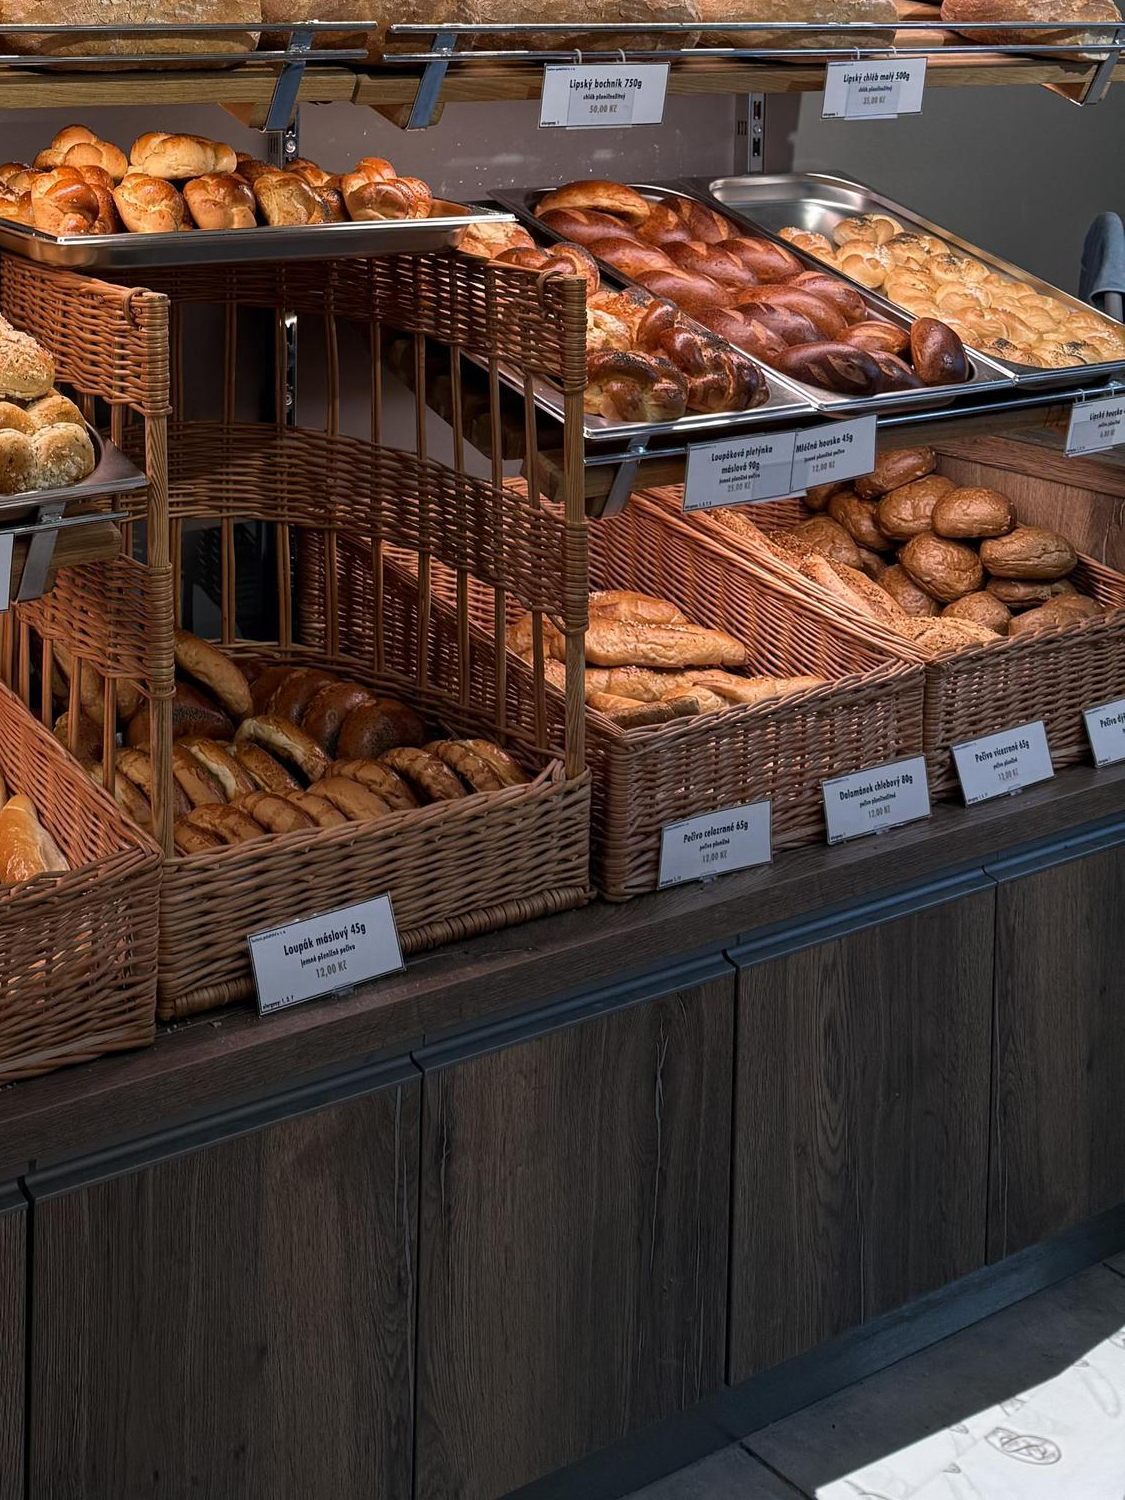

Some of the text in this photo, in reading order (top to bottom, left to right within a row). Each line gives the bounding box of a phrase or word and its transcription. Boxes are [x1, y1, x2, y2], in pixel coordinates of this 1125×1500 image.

[570, 79, 642, 90] Lipský bochník 750g
[843, 71, 910, 84] Lipský chléb malý 500g
[589, 104, 618, 113] 50,00 Kč
[796, 433, 853, 453] Mléčná houska 45g
[712, 445, 773, 461] Loupáková pletýnka
[722, 461, 760, 474] máslová 90g
[975, 751, 993, 762] Pečivo
[840, 774, 913, 800] Dalamánek chlebový 80g
[684, 820, 748, 843] Pečivo celozrnné 65g
[284, 923, 366, 956] Loupák máslový 45g
[316, 960, 347, 978] 12,00 Kč
